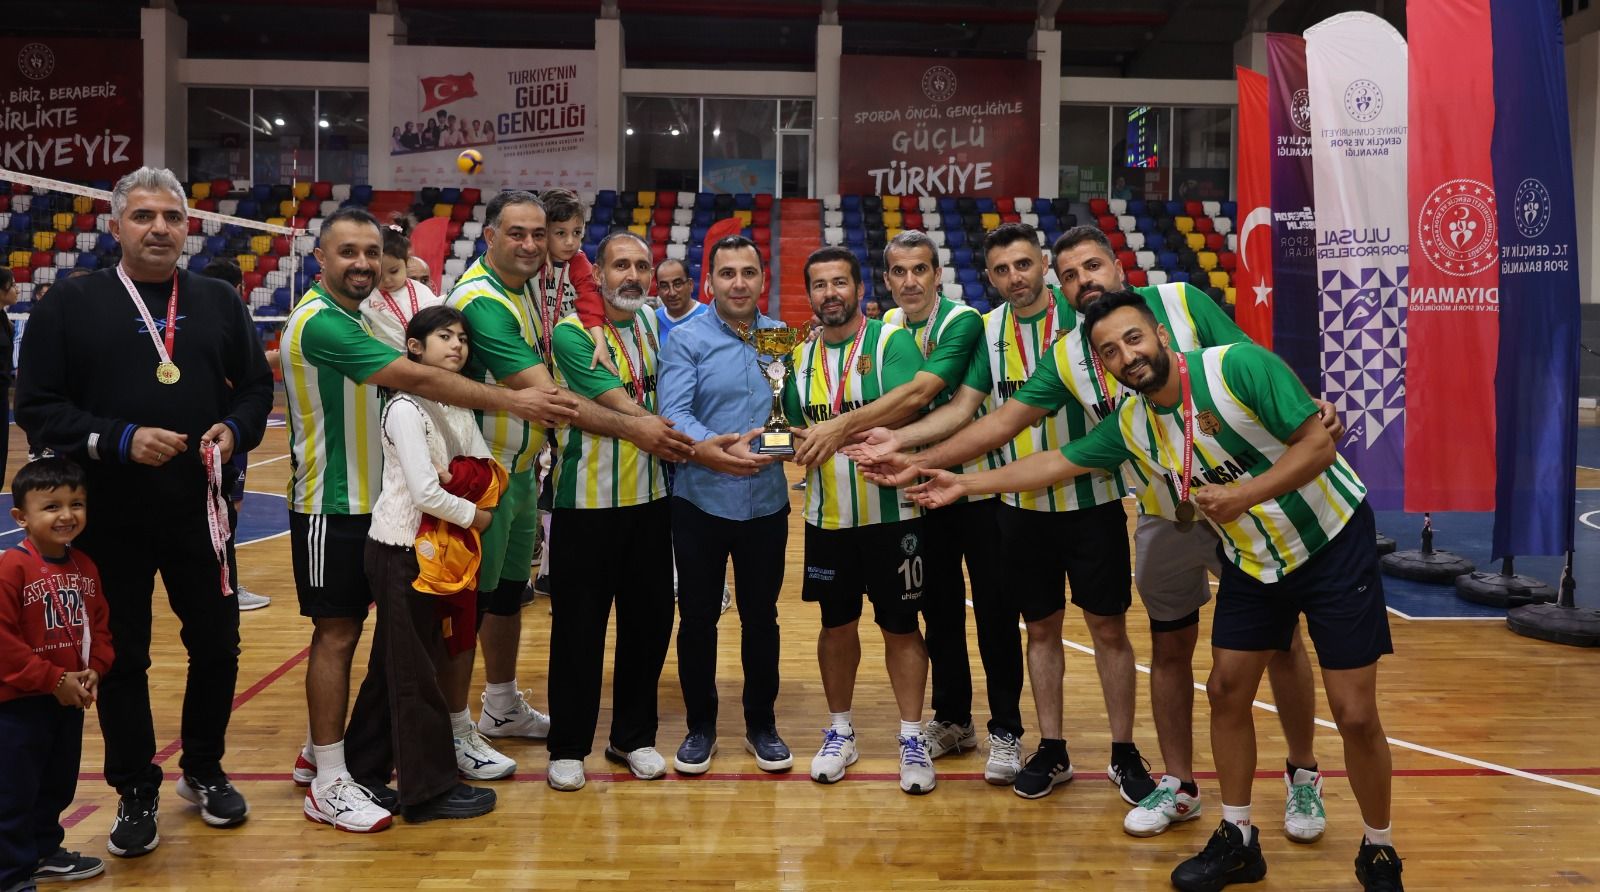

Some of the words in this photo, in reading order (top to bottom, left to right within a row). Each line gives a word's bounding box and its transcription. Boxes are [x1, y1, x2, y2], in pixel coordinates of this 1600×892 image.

[50, 81, 117, 100] BERABERİZ
[515, 82, 568, 108] GÜCÜ
[855, 109, 901, 124] SPORDA
[946, 100, 1023, 119] GENÇLİĞİYLE
[892, 119, 985, 154] GÜÇLÜ
[868, 156, 993, 197] TÜRKİYE
[898, 555, 923, 590] 10
